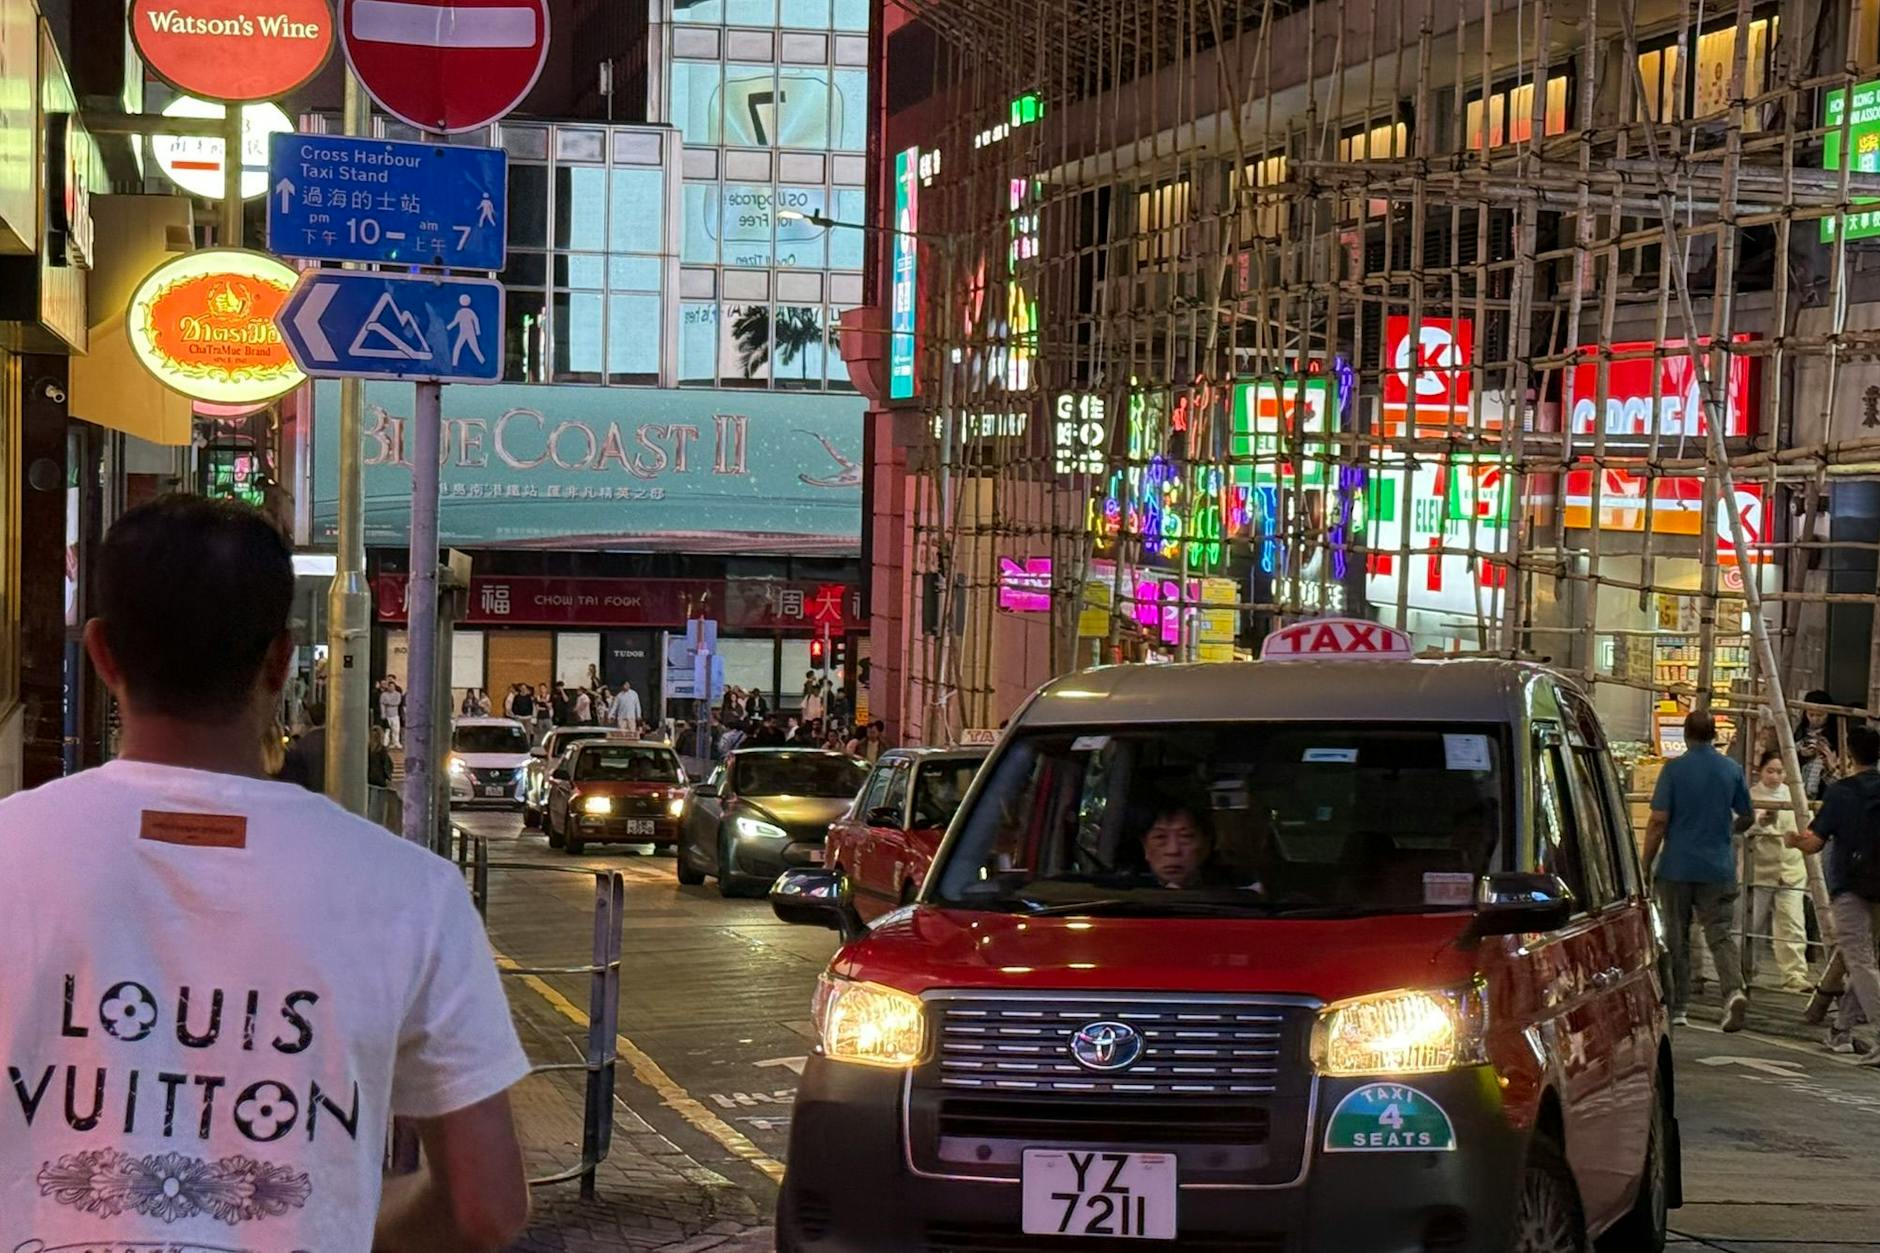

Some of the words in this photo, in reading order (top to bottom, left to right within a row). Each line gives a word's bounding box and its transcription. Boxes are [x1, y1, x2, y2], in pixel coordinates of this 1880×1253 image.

[148, 11, 252, 37] Watson's
[257, 15, 319, 39] Wine
[300, 145, 350, 163] Cross
[354, 148, 422, 168] Harbour
[300, 163, 333, 179] Taxi
[338, 167, 388, 183] Stand
[301, 185, 421, 214] 過海的士站
[309, 213, 330, 224] pm
[419, 221, 439, 232] am
[301, 228, 338, 246] 下午
[412, 237, 447, 253] 上午
[452, 226, 472, 251] 7
[244, 344, 271, 357] Brand
[494, 407, 699, 480] COAST
[712, 414, 751, 475] II
[533, 595, 573, 607] CHOW
[577, 596, 599, 606] TAI
[1282, 624, 1393, 653] TAXI
[613, 650, 645, 658] TUDOR
[61, 973, 320, 1054] LOUIS
[8, 1064, 359, 1142] VUITTON
[1360, 1088, 1413, 1104] TAXI
[1378, 1104, 1403, 1129] 4
[1353, 1133, 1432, 1147] SEATS
[1067, 1152, 1131, 1194] YZ
[1050, 1193, 1145, 1236] 7211
